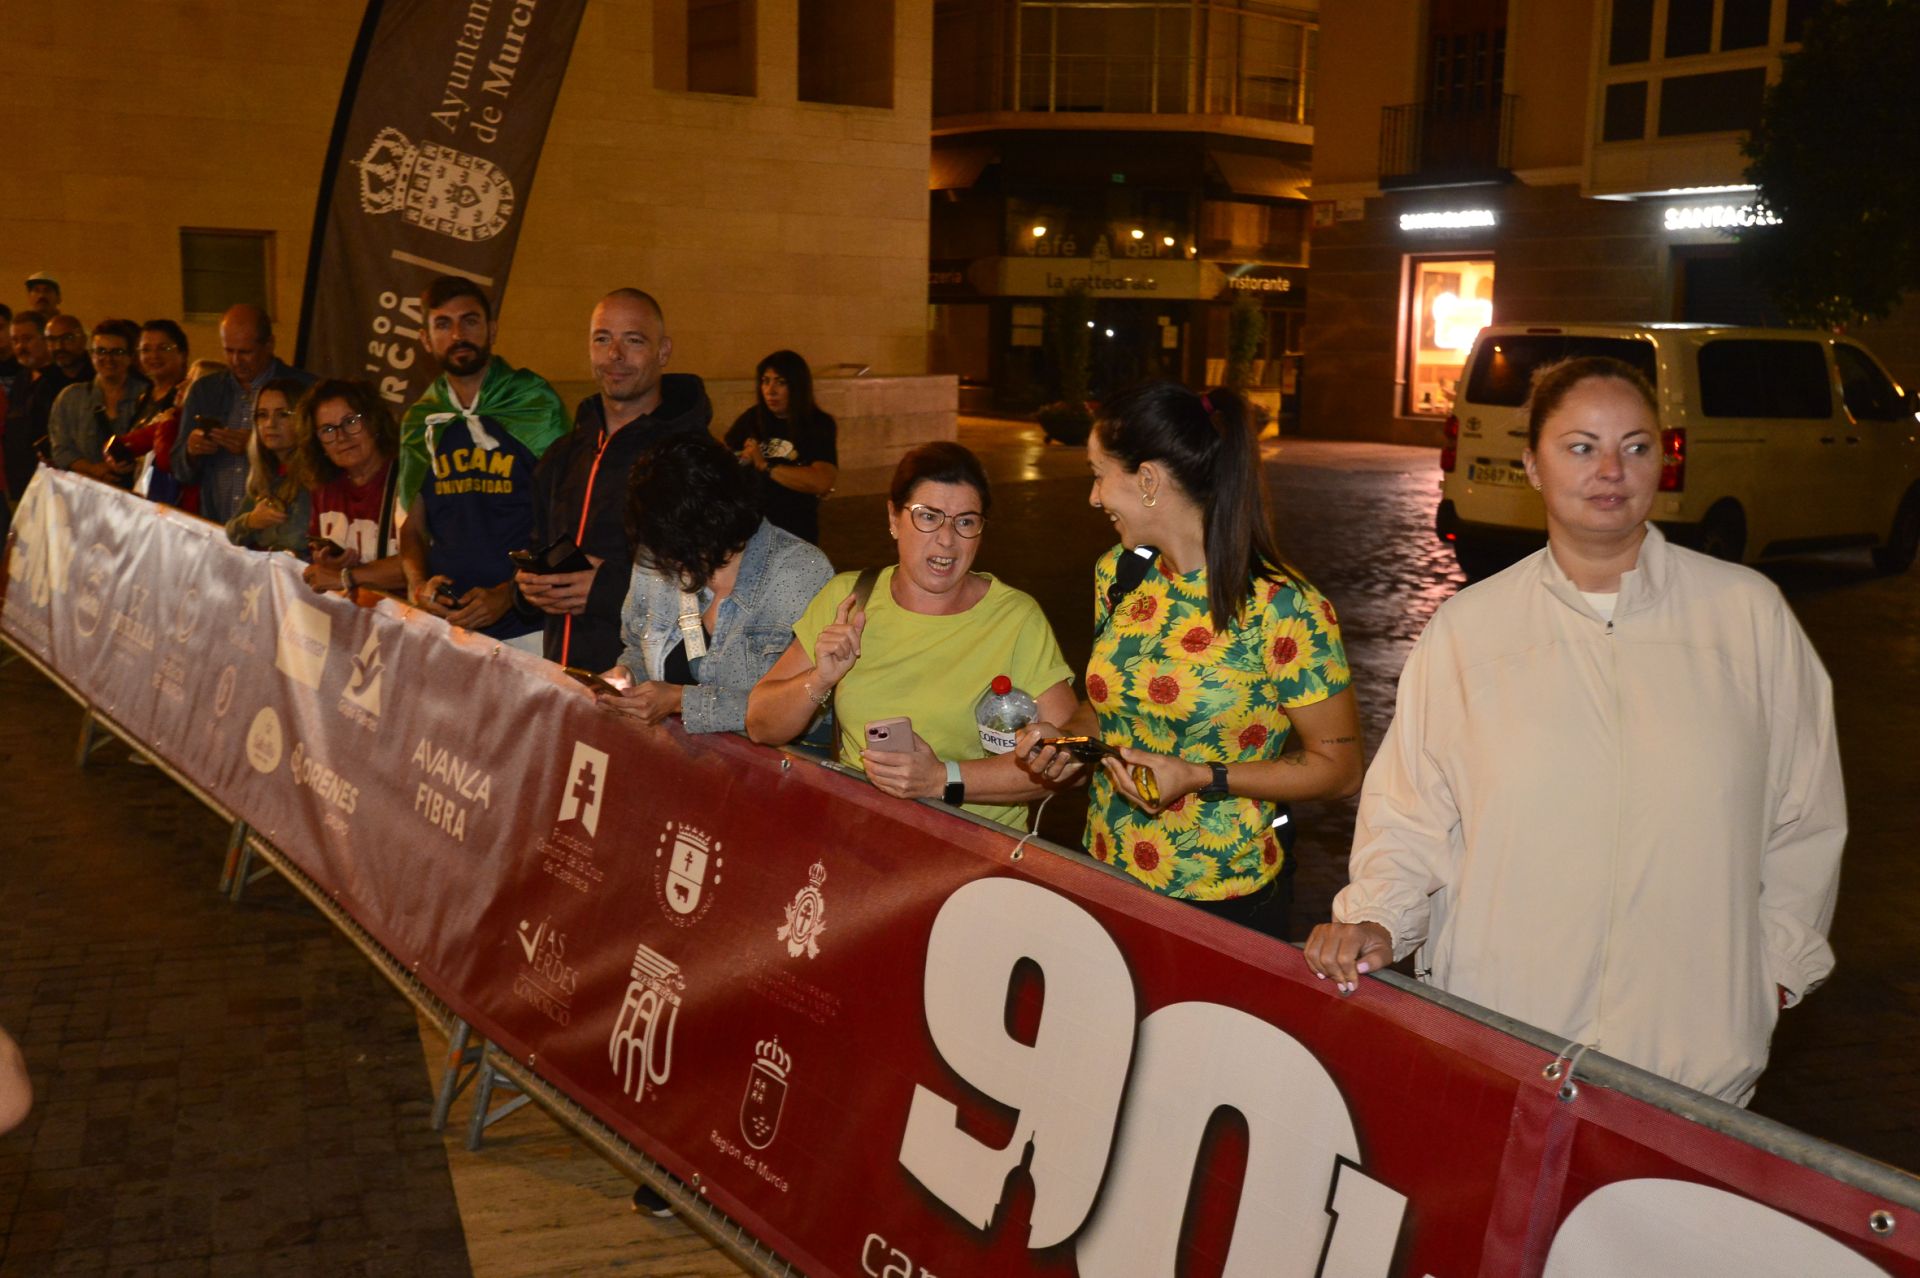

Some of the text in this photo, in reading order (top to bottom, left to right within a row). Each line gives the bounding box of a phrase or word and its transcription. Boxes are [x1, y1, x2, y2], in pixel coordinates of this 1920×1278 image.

[469, 106, 502, 144] de
[1228, 274, 1291, 292] ristorante
[434, 448, 514, 479] UCAM
[415, 782, 467, 842] FIBRA
[743, 1153, 756, 1170] de
[756, 1161, 788, 1193] Murcia
